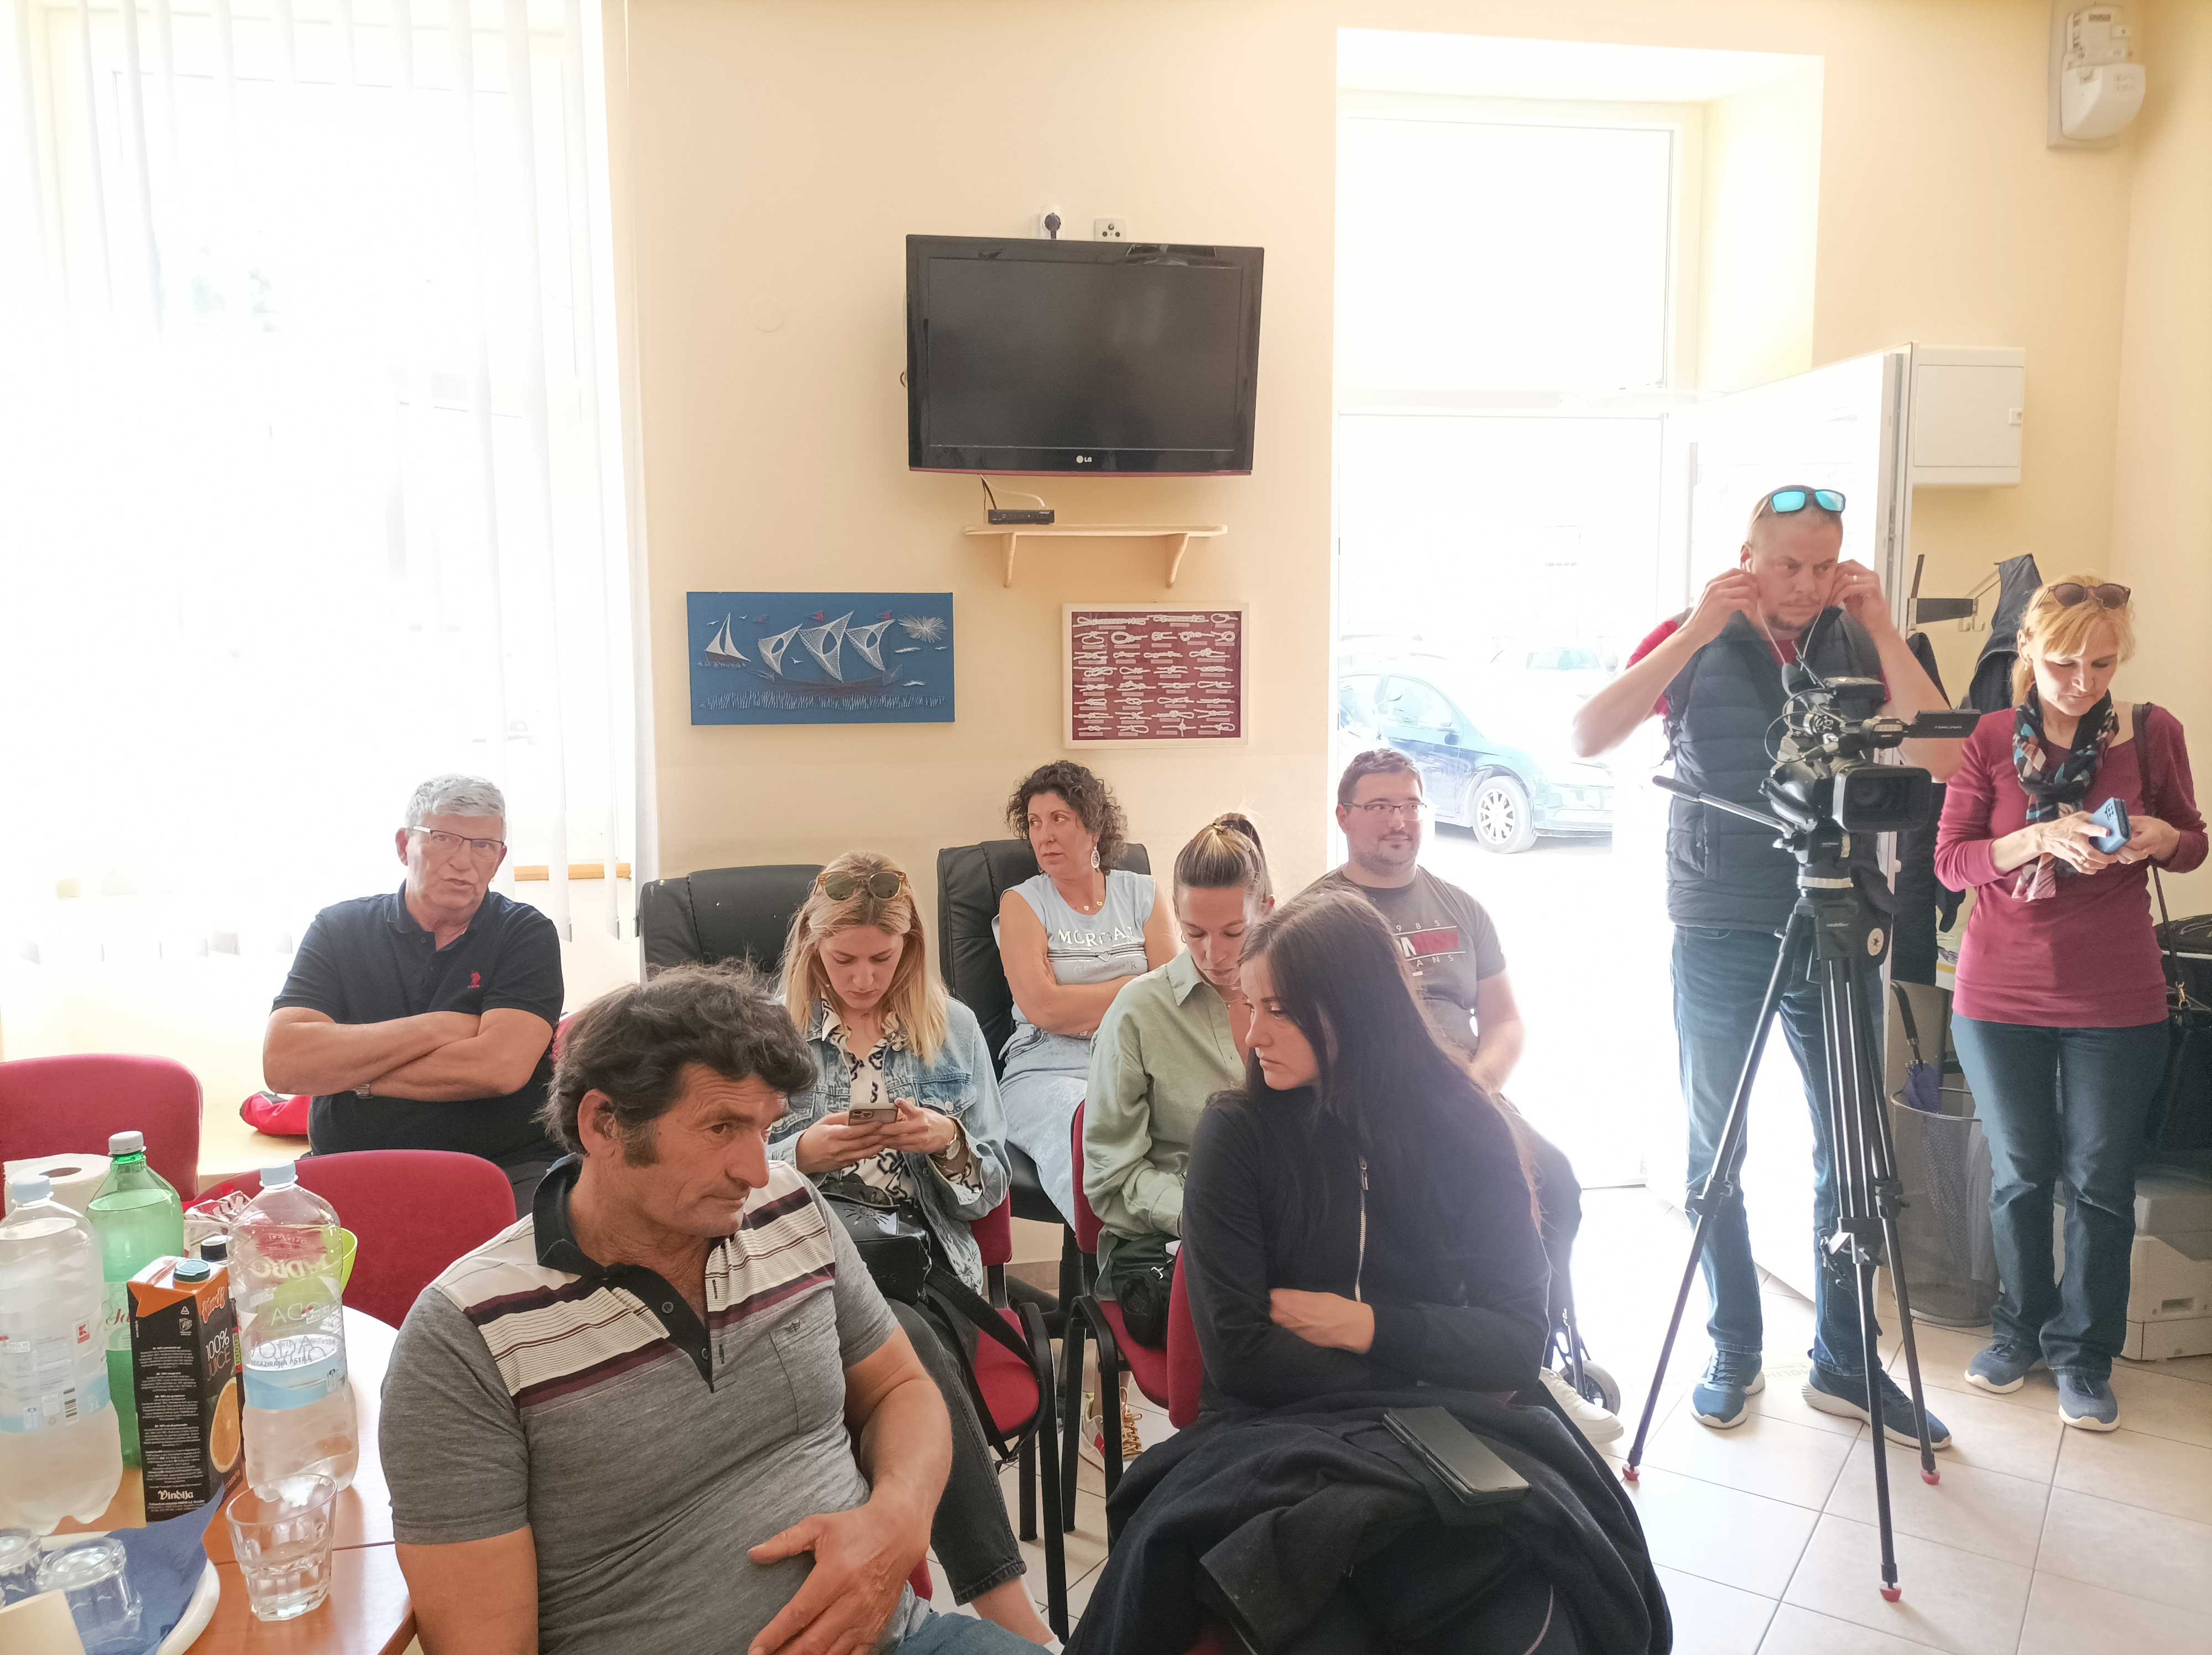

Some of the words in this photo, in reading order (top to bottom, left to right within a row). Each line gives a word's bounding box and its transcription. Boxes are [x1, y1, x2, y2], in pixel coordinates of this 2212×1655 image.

[1395, 920, 1441, 932] 985
[1416, 954, 1454, 967] ANS
[205, 1328, 230, 1362] 100%
[207, 1345, 231, 1381] JUICE
[158, 1490, 194, 1500] Vindija
